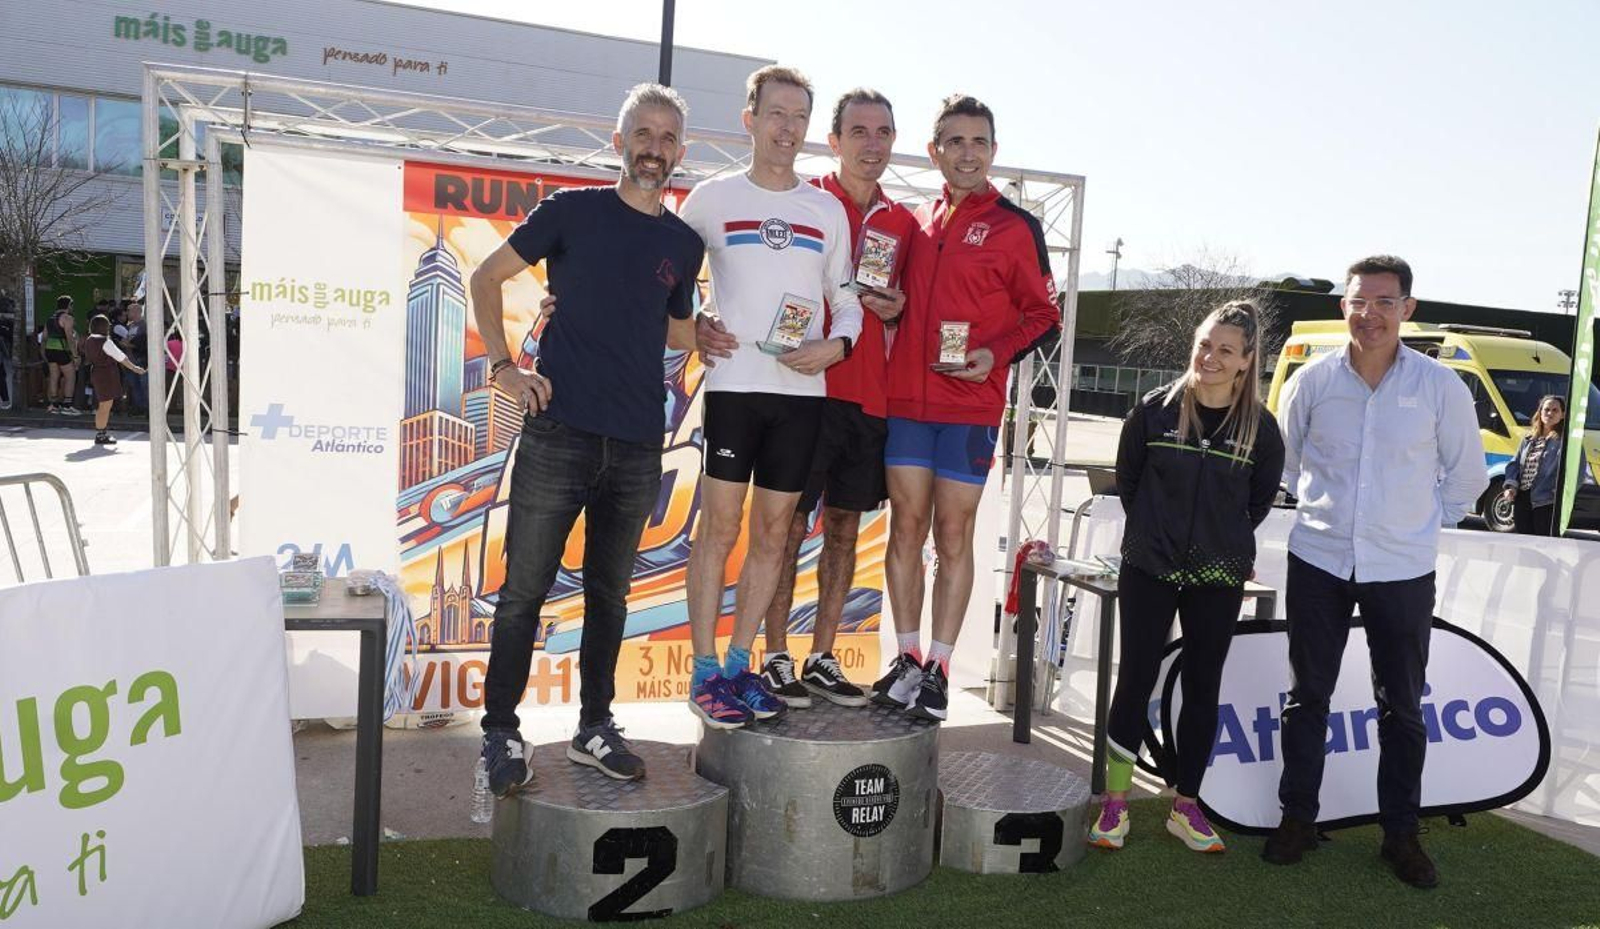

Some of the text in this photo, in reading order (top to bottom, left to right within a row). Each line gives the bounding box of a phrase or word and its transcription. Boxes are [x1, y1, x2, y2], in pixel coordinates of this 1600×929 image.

[114, 12, 187, 47] máis
[216, 30, 287, 64] auga
[322, 47, 448, 76] pensado para ti
[434, 173, 560, 217] RUN
[250, 277, 391, 313] máis que auga
[270, 313, 322, 329] pensado
[288, 424, 388, 441] DEPORTE
[311, 438, 385, 454] Atlántico
[639, 645, 654, 677] 3
[403, 658, 527, 711] VIG
[636, 676, 672, 698] MÁIS
[854, 777, 885, 795] TEAM
[851, 804, 886, 824] RELAY
[67, 829, 107, 897] ti
[587, 825, 679, 922] 2
